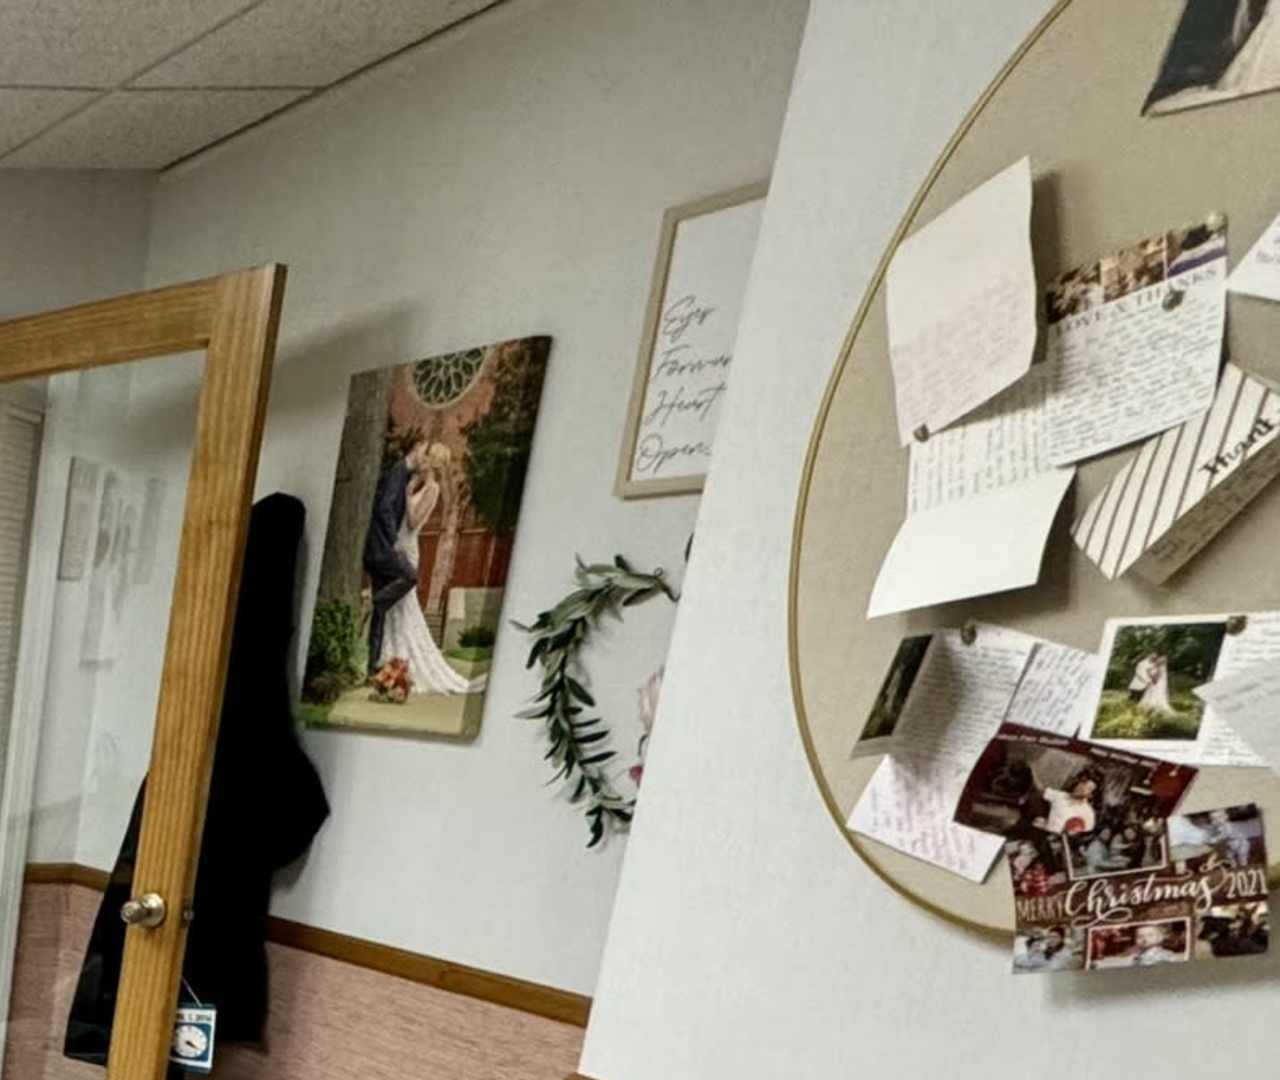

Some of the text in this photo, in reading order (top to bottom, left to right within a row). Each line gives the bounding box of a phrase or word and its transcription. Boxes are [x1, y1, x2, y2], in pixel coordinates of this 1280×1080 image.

[1016, 897, 1065, 922] MERRY
[1065, 866, 1218, 924] Christmas
[1226, 867, 1269, 899] 2021
